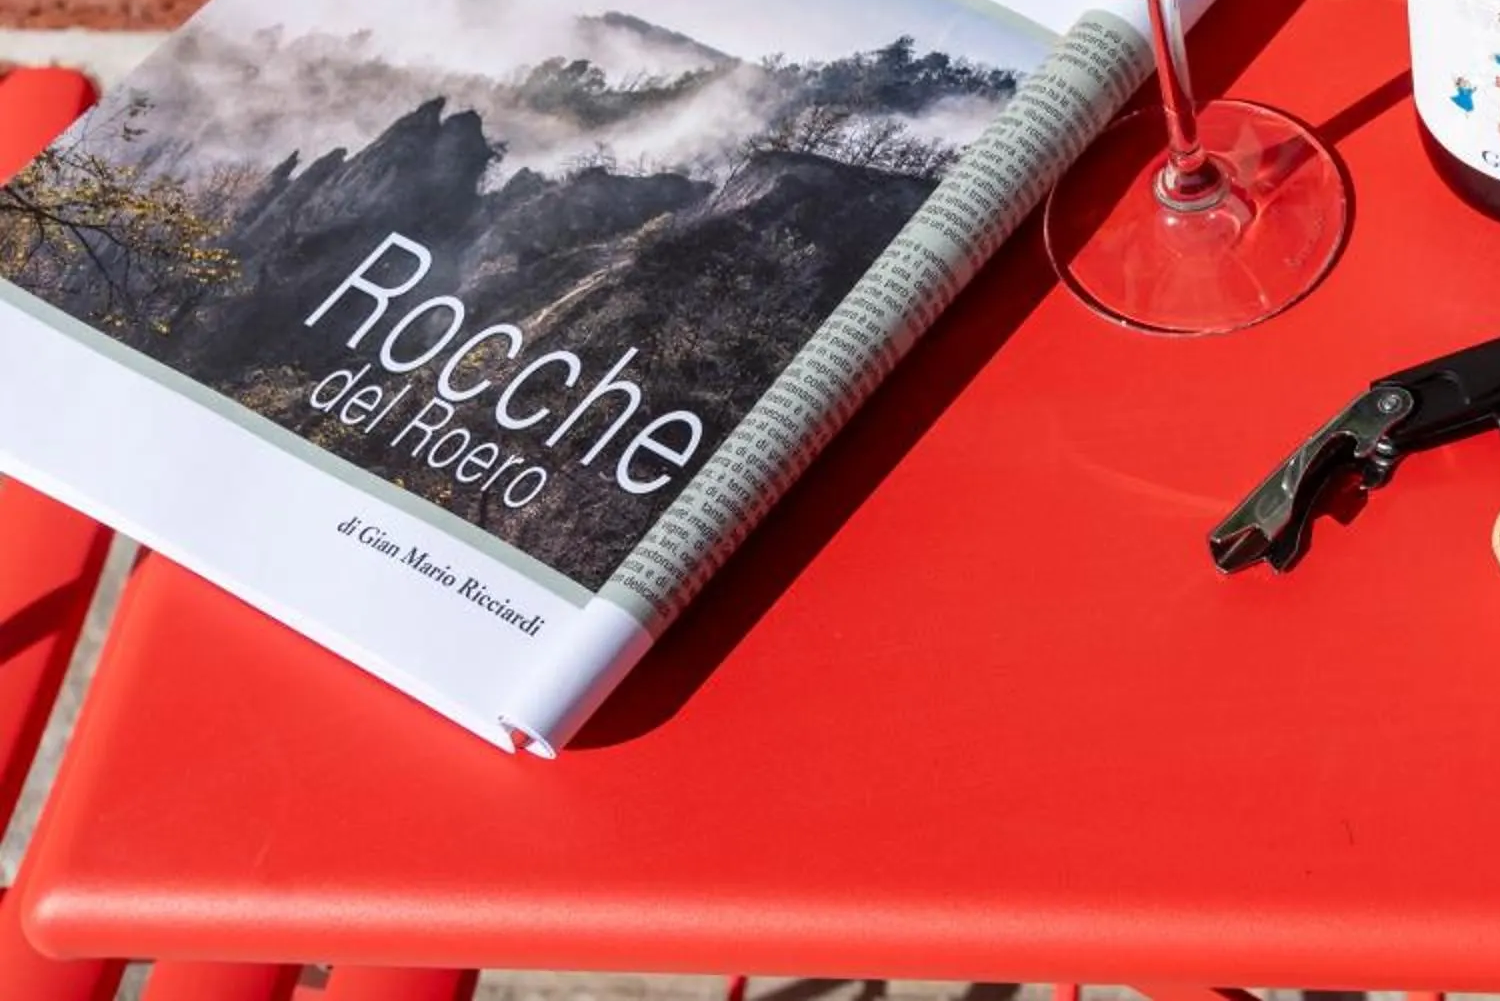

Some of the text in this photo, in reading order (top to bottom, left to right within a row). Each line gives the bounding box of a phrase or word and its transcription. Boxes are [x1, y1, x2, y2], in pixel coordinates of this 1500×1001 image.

[304, 231, 704, 494] Rocche
[309, 363, 548, 510] del Roero
[337, 516, 546, 639] di Gian Mario Ricciardi
